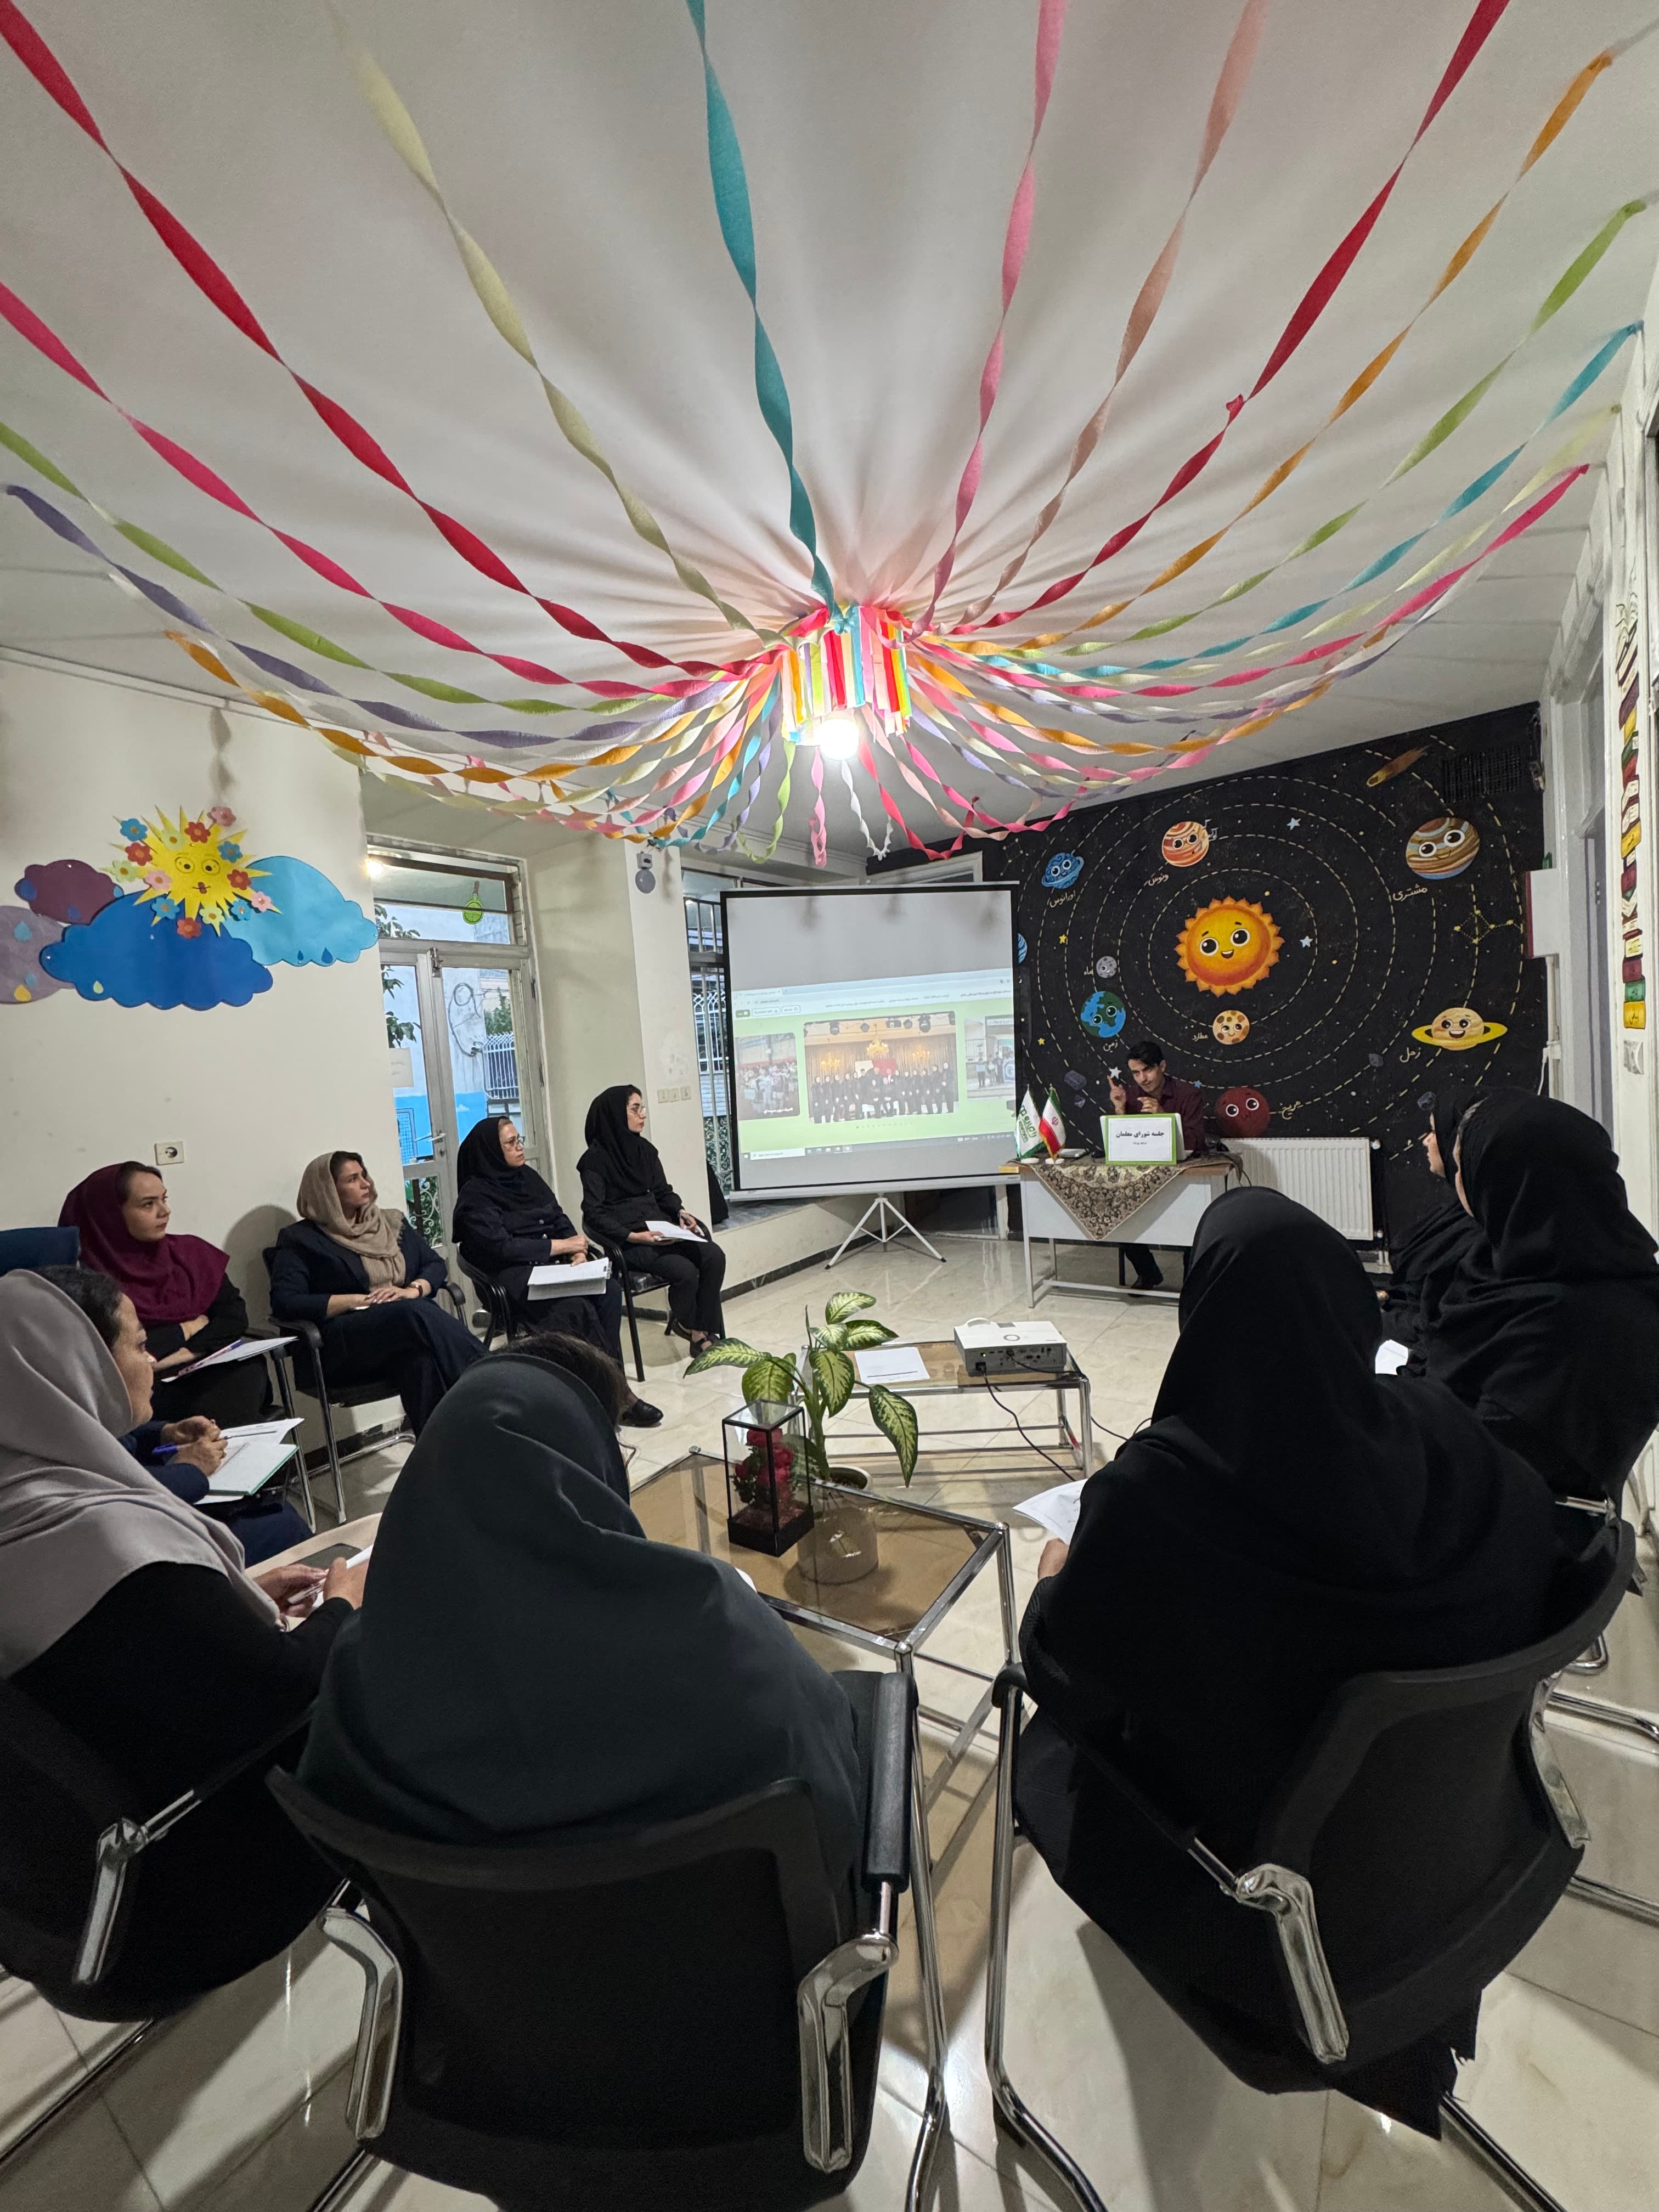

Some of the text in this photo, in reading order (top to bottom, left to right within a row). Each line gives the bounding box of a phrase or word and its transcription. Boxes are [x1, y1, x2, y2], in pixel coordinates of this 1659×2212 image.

[1148, 873, 1169, 886] ونوس
[1049, 889, 1076, 908] اورانوس
[1393, 883, 1428, 902] مشتری
[1192, 1031, 1209, 1042] عطارد
[1103, 1039, 1118, 1053] زمین
[1400, 1047, 1421, 1063] زحل
[1281, 1101, 1301, 1120] مریخ
